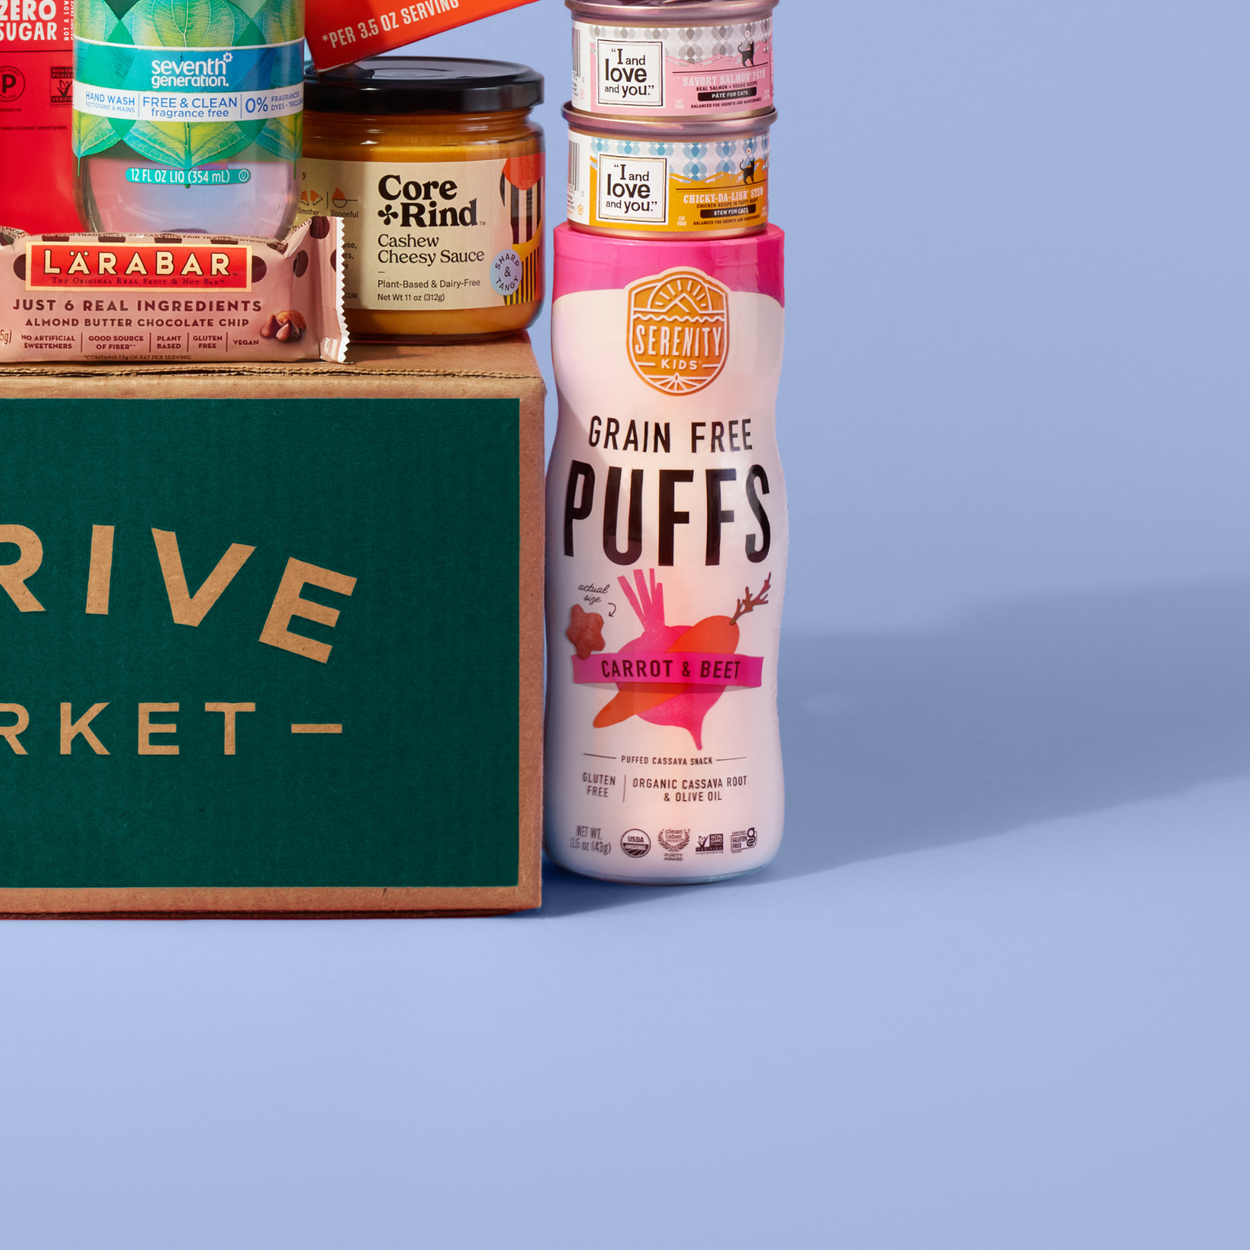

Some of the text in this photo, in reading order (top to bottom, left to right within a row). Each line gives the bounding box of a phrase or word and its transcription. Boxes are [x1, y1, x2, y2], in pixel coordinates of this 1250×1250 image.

[358, 19, 379, 40] 3.5
[380, 13, 400, 31] OZ
[151, 57, 227, 75] seventh
[626, 54, 646, 65] and
[605, 58, 648, 82] love
[151, 76, 229, 89] generation.
[604, 84, 620, 94] and
[86, 91, 136, 106] HAND WASH
[143, 97, 238, 108] FREE & CLEAN
[246, 97, 269, 114] 0%
[151, 108, 229, 118] fragrance free
[378, 175, 458, 200] Core
[400, 198, 477, 227] Rind
[378, 234, 440, 248] Cashew
[44, 248, 230, 276] LÄRABAR
[378, 250, 485, 267] Cheesy Sauce
[378, 279, 481, 290] Plant-Based & Dairy-Free
[12, 299, 262, 312] JUST 6 REAL INGREDIENTS
[25, 318, 250, 327] ALMOND BUTTER CHOCOLATE CHIP
[635, 324, 722, 358] SERENITY
[661, 359, 699, 370] KIDS
[589, 415, 753, 453] GRAIN FREE
[564, 460, 771, 566] PUFFS
[601, 659, 741, 680] CARROT & BEET
[582, 773, 616, 786] GLUTEN
[587, 786, 609, 798] FREE
